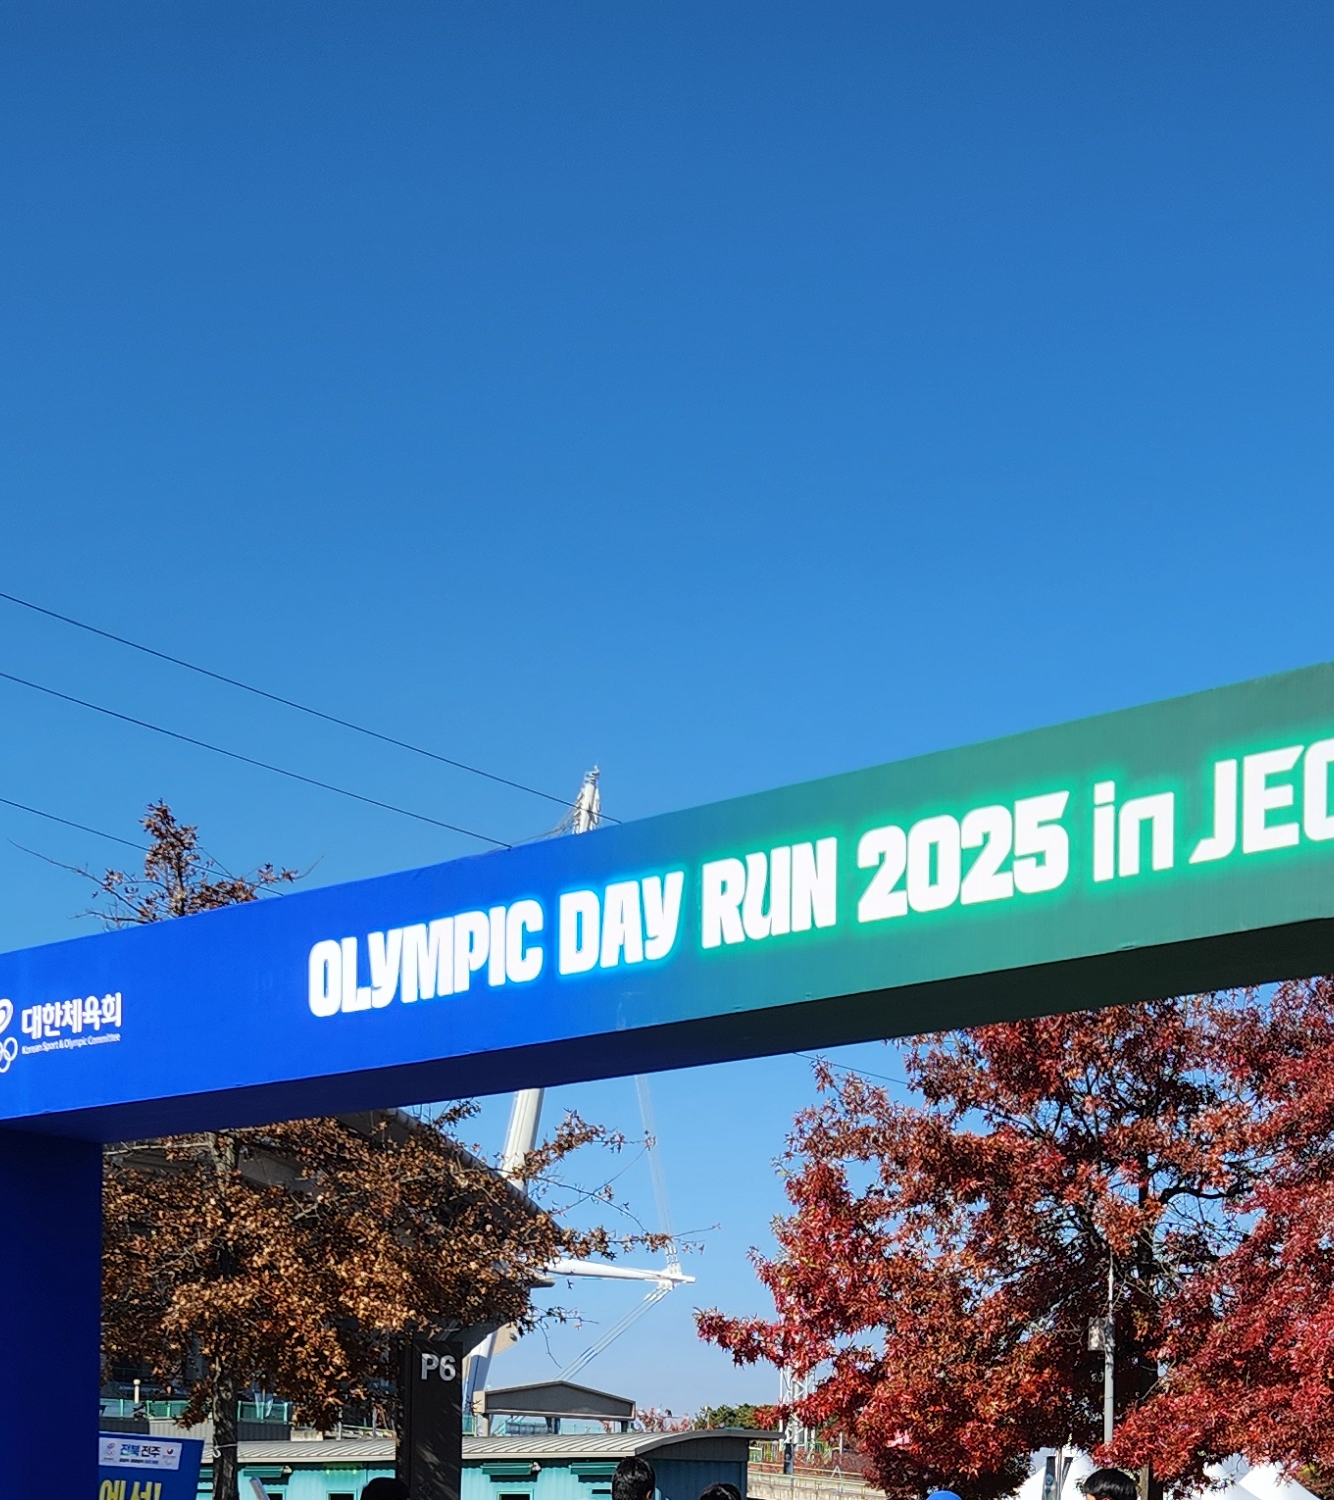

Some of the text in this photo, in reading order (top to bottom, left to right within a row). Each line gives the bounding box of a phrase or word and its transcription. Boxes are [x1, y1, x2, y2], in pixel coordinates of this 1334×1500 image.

[309, 899, 543, 1017] OLYMPIC
[559, 871, 683, 975] DAY
[701, 837, 837, 949] RUN
[857, 791, 1069, 922] 2025
[1093, 780, 1174, 882] in
[21, 991, 122, 1040] 대한체육회
[421, 1353, 456, 1381] P6
